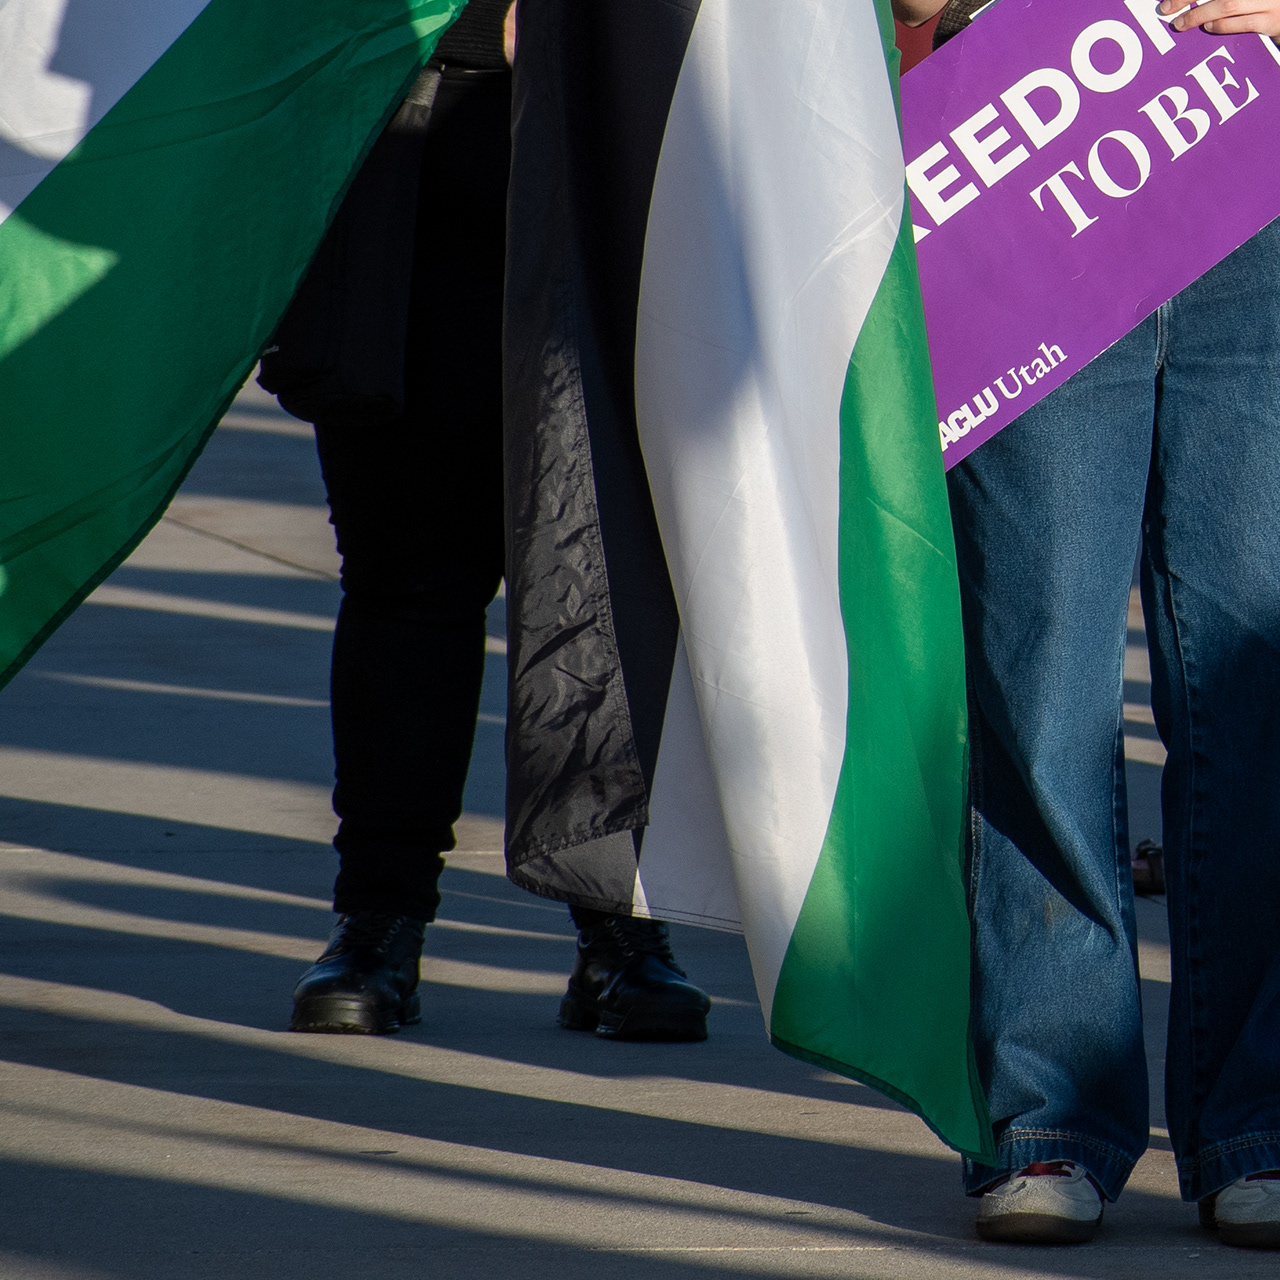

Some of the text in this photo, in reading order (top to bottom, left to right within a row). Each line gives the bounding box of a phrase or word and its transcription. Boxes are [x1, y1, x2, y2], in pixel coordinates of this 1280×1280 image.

[1029, 45, 1261, 239] TO BE
[938, 341, 1069, 452] ACLU Utah
